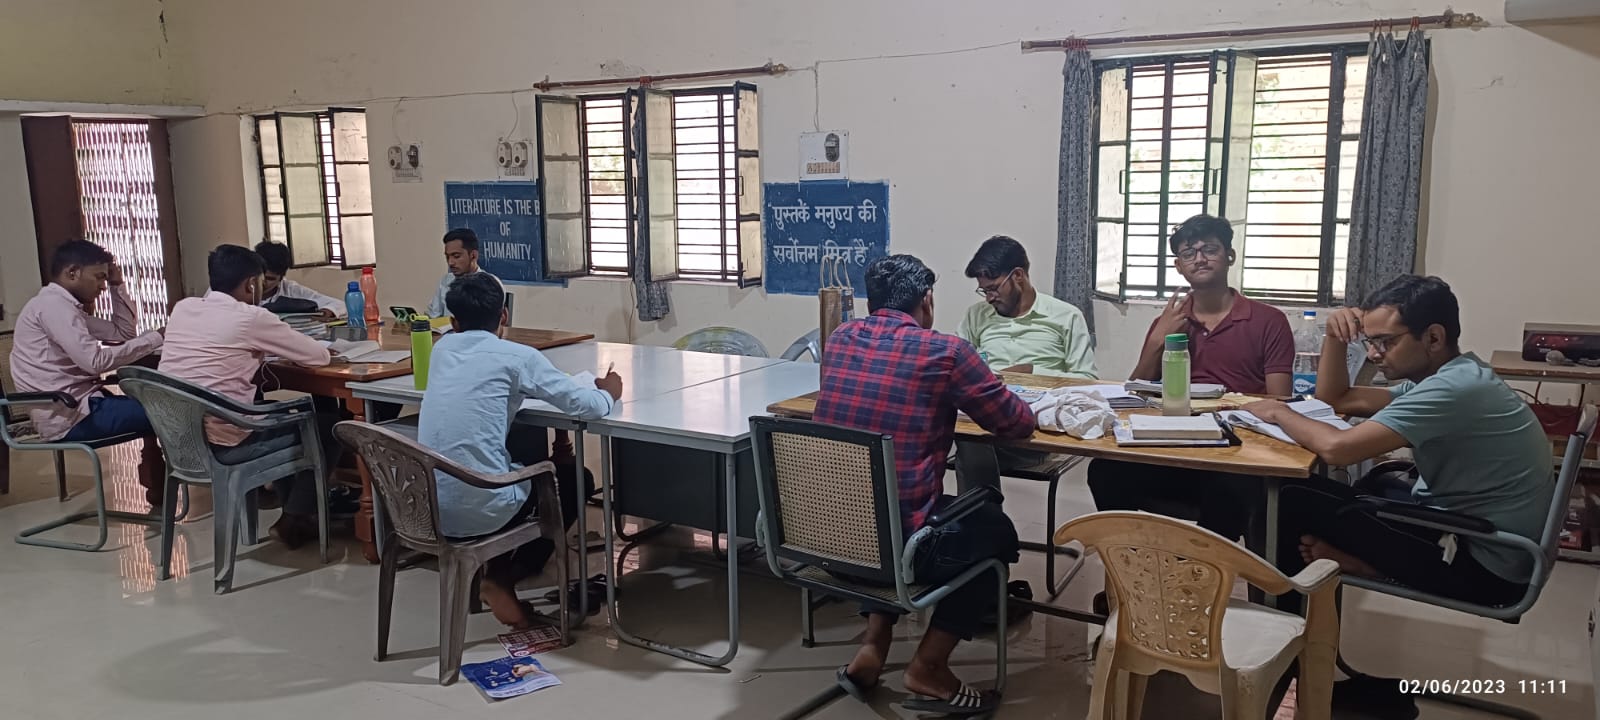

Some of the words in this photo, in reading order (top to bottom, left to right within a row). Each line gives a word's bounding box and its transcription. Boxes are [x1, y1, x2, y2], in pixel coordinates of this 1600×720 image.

[450, 198, 501, 215] LITERATURE
[503, 198, 513, 214] IS
[514, 199, 532, 215] THE
[534, 199, 540, 215] B
[815, 206, 854, 229] मनुष्य
[858, 199, 877, 222] की
[500, 222, 511, 236] OF
[483, 241, 535, 260] HUMANITY.
[773, 238, 818, 264] सर्वोत्तम
